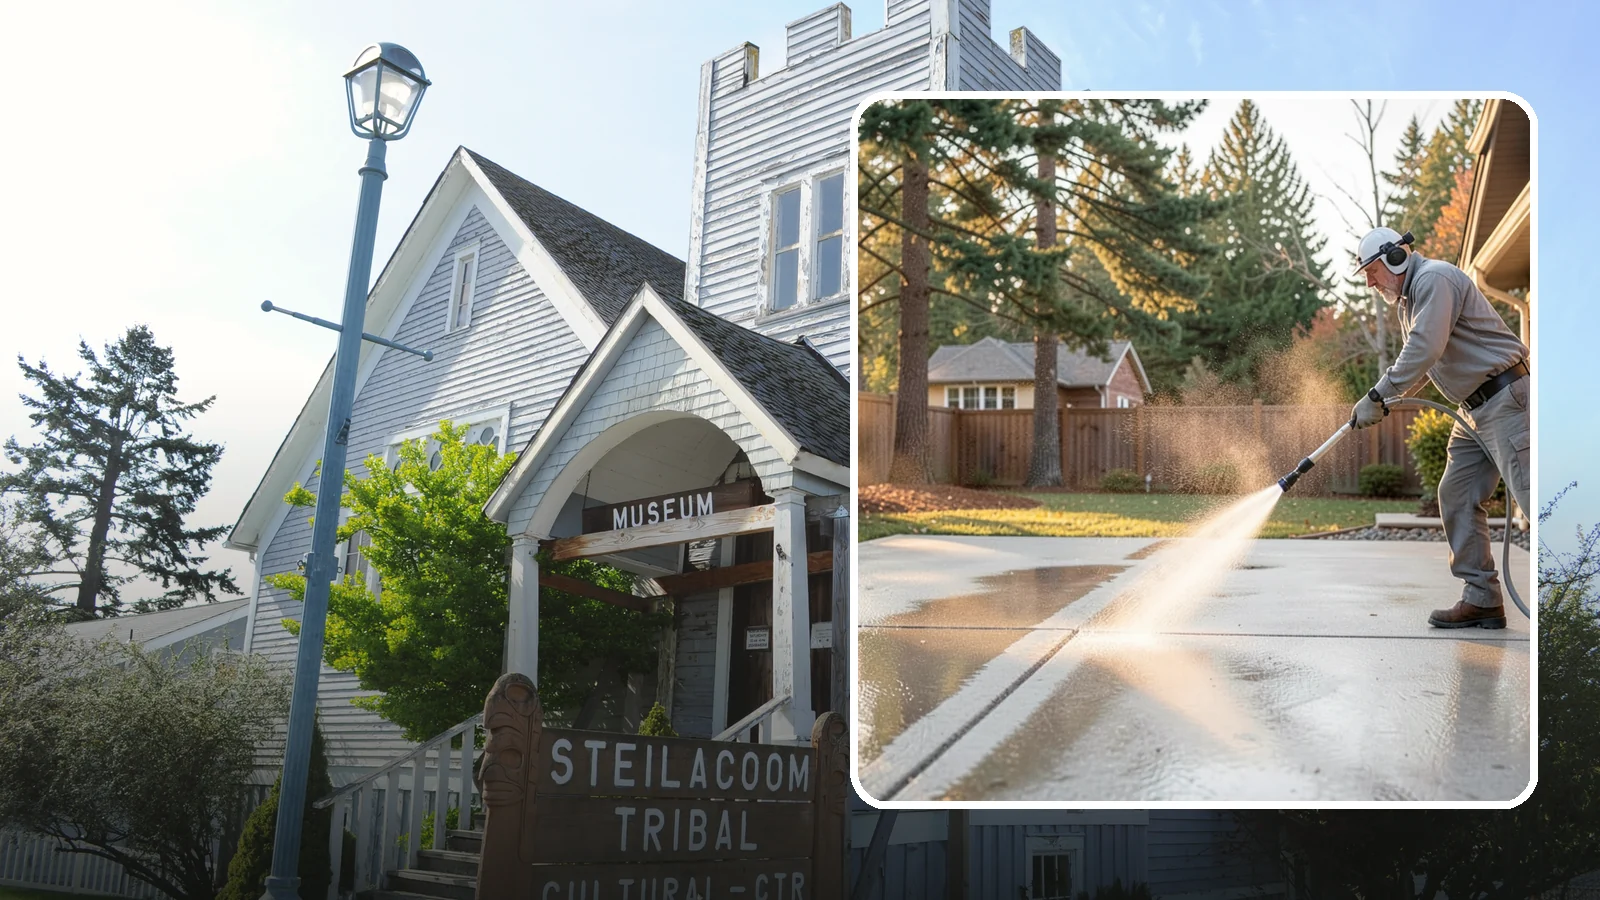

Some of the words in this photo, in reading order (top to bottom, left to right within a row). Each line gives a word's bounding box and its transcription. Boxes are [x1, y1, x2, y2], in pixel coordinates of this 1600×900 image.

[612, 491, 714, 531] MUSEUM
[550, 738, 810, 793] STEILACOOM
[614, 807, 758, 852] TRIBAL
